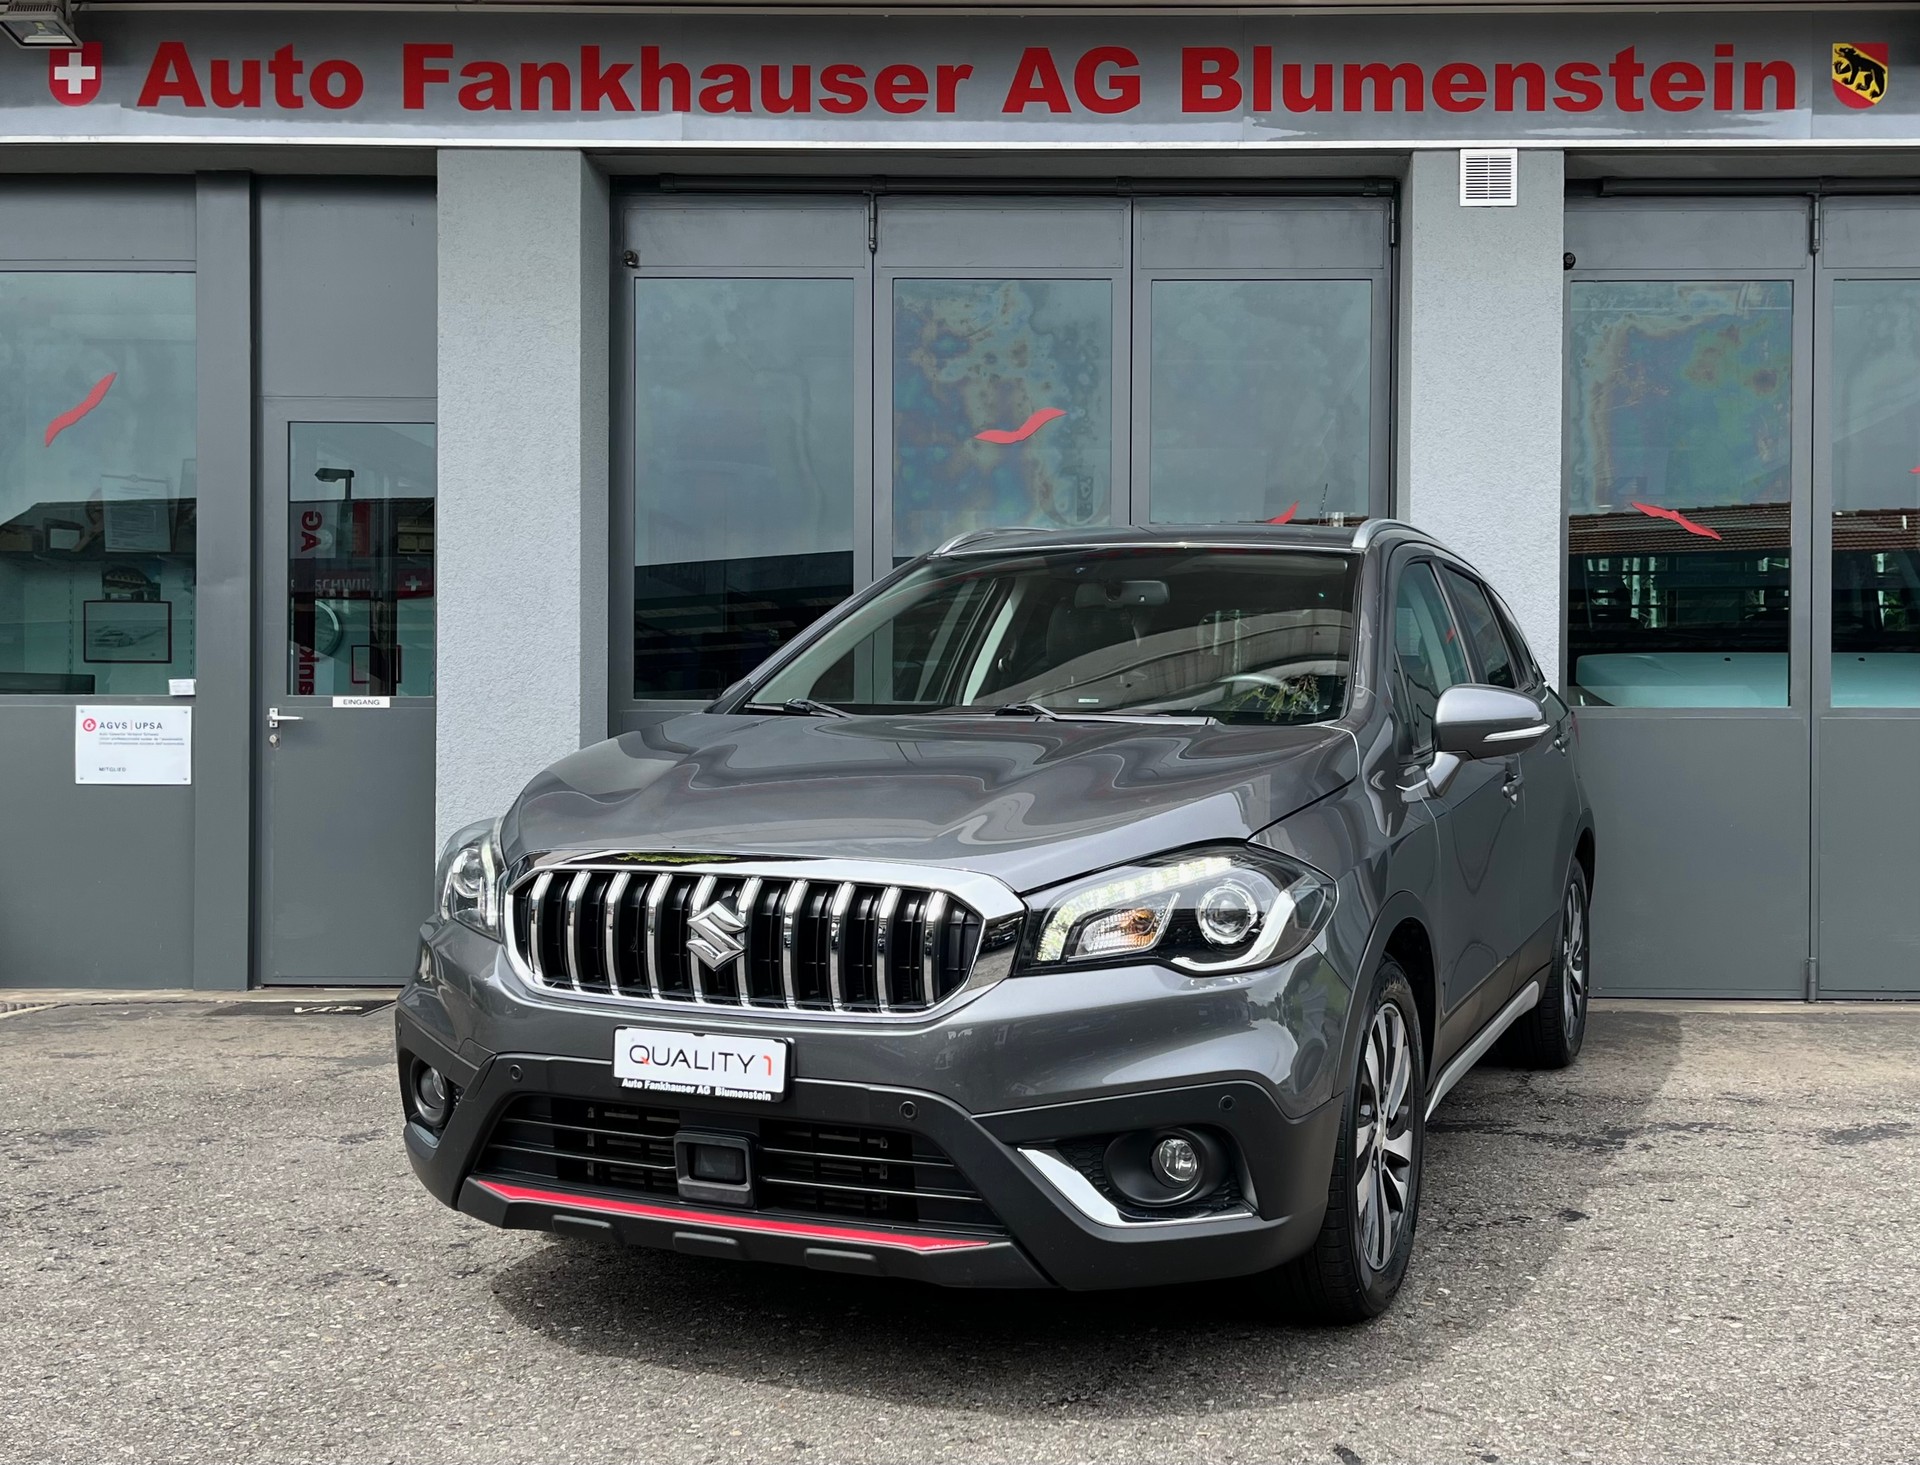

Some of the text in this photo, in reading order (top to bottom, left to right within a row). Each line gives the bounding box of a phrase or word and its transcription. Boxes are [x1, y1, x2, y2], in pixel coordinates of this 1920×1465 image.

[137, 41, 1797, 115] Auto Fankhauser AG Blumenstein
[342, 698, 381, 706] EINGANG
[98, 721, 164, 730] AGVS UPSA
[629, 1044, 756, 1074] QUALITY
[621, 1078, 772, 1101] Auto Fankhauser AG Blumenstein
